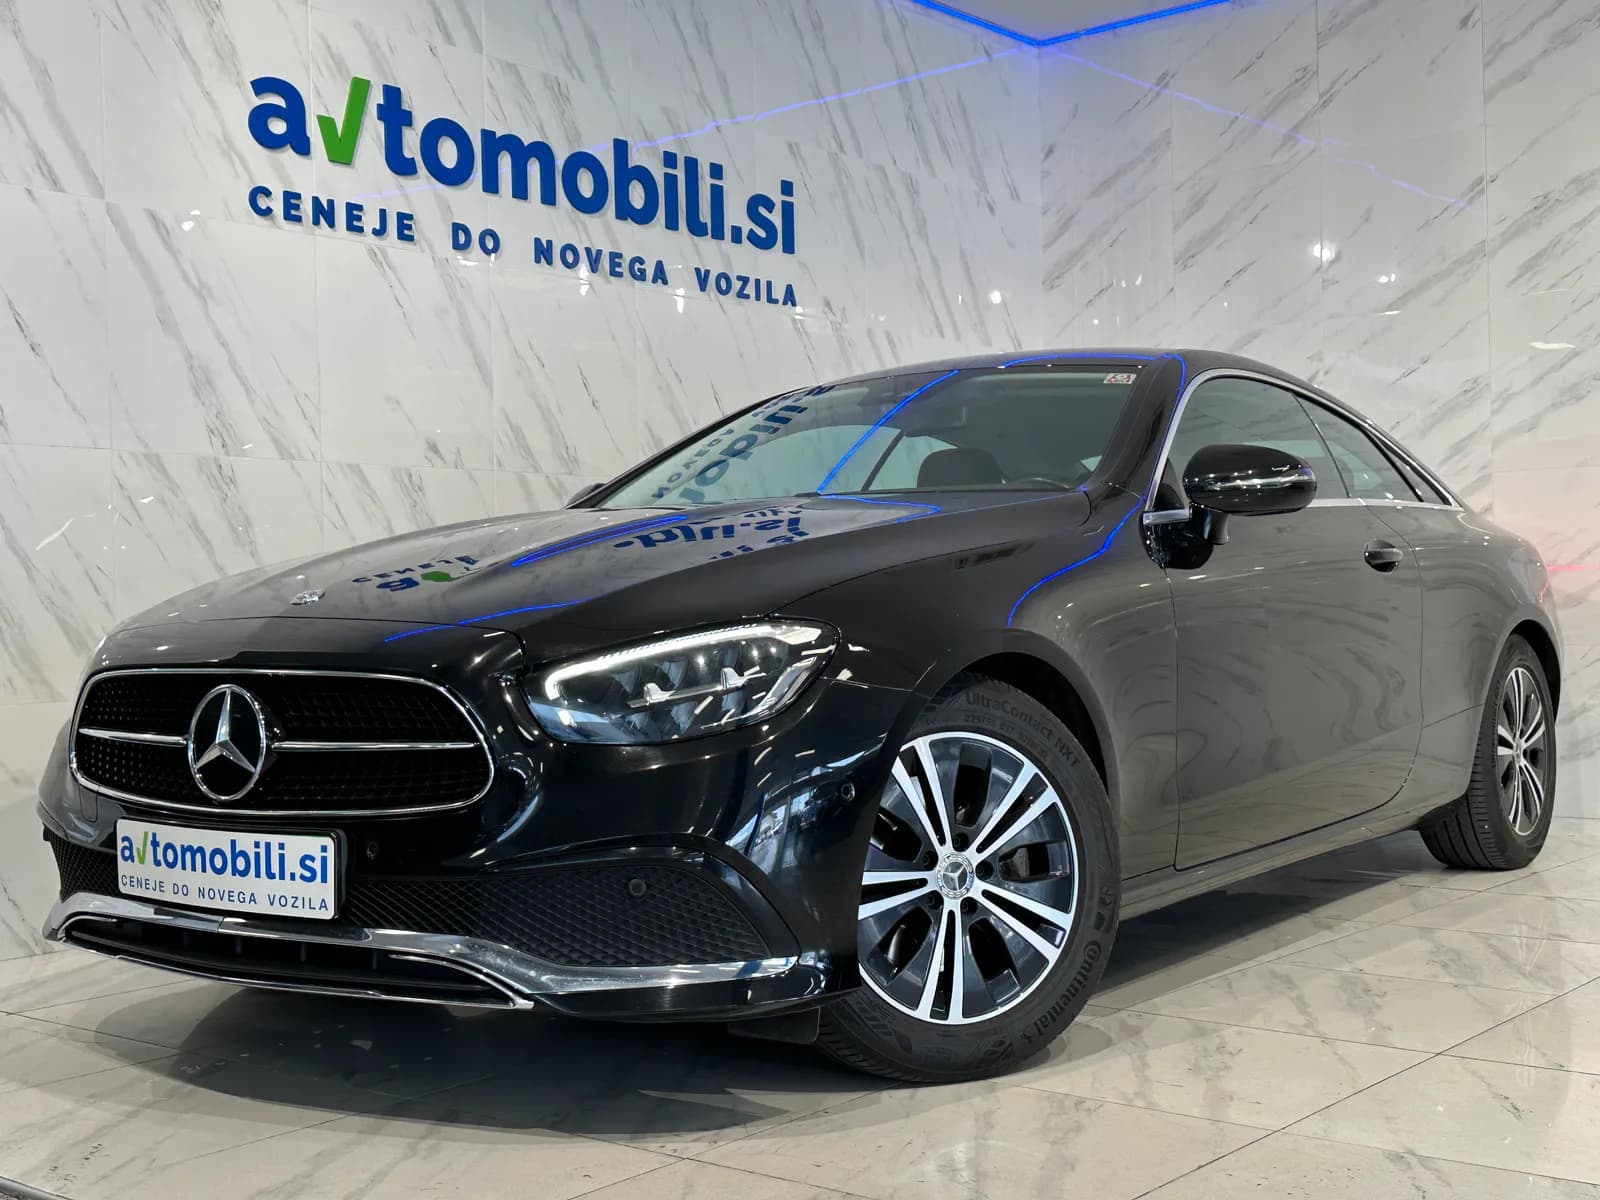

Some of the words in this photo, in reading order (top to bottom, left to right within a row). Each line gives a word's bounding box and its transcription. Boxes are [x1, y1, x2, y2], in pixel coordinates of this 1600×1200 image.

[248, 185, 416, 243] CENEJE
[451, 222, 501, 256] DO
[534, 237, 669, 286] NOVEGA
[694, 267, 798, 308] VOZILA
[121, 874, 165, 893] CENEJE
[172, 882, 189, 897] DO
[198, 886, 257, 905] NOVEGA
[267, 894, 329, 911] VOZILA
[1034, 940, 1101, 1036] Continental
